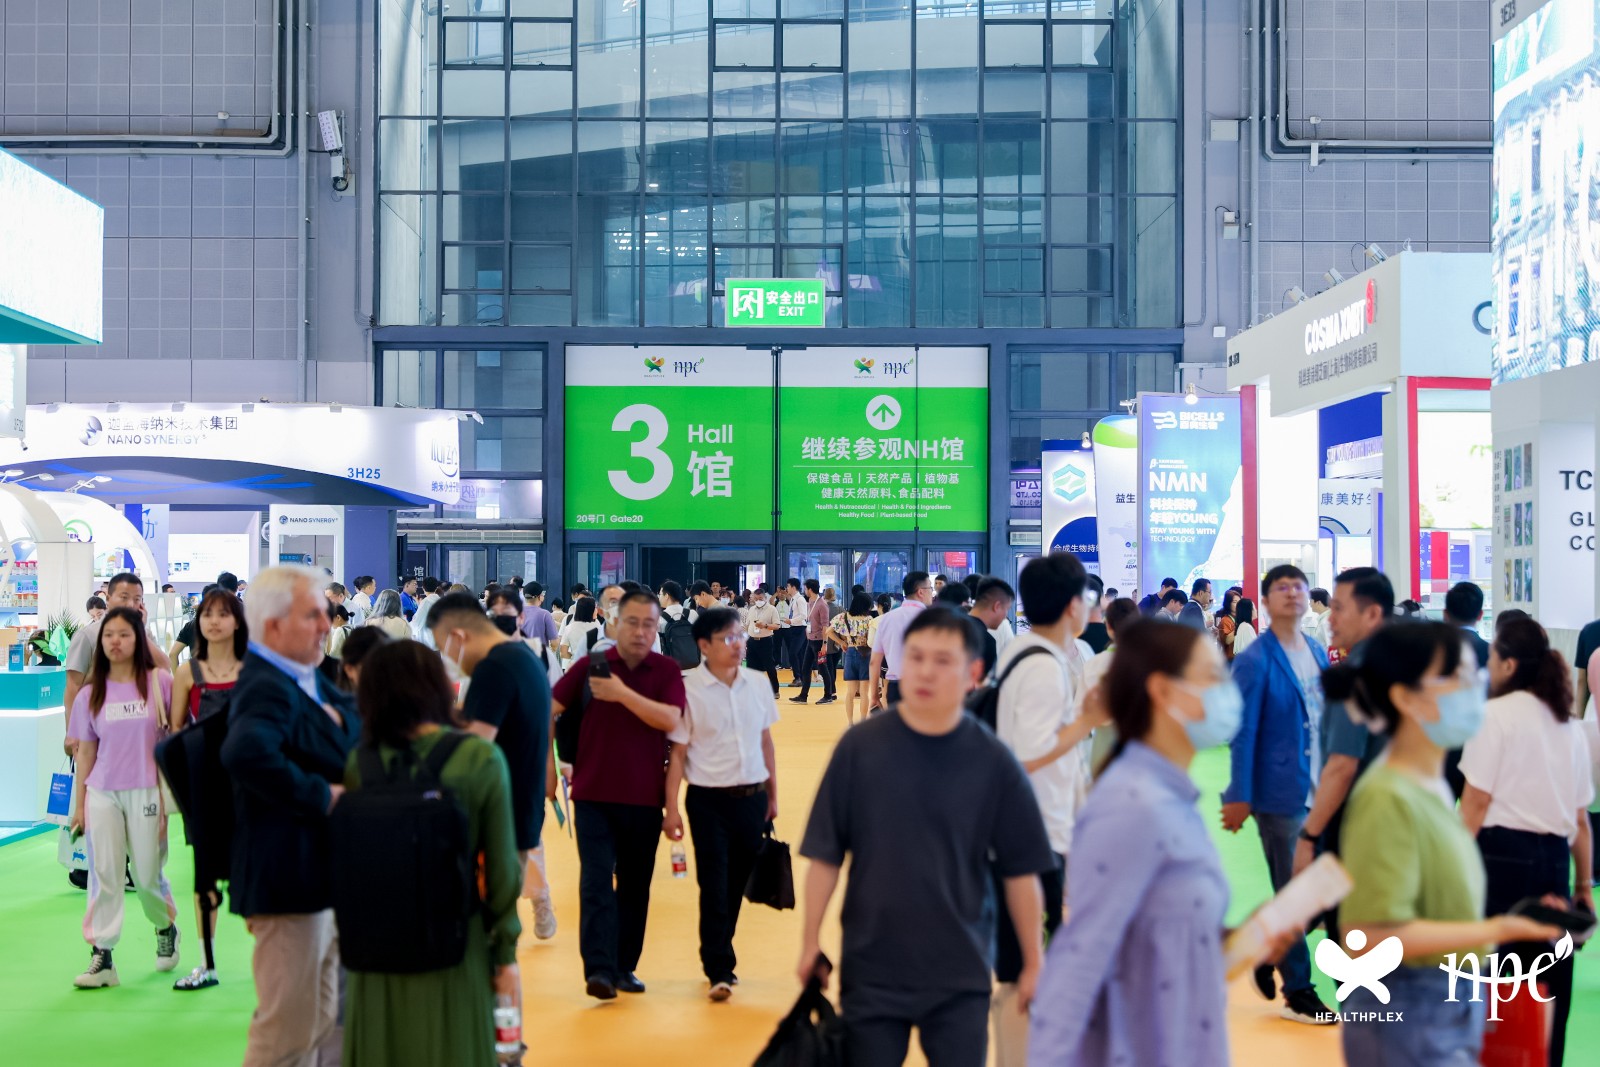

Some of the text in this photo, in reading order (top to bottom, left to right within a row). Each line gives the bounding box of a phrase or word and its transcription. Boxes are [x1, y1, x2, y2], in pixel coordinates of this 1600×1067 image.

[766, 290, 819, 305] 安全出口
[778, 306, 805, 316] EXIT
[673, 358, 703, 377] npc
[883, 358, 913, 378] npc
[107, 434, 142, 445] NANO
[688, 424, 733, 443] Hall
[607, 403, 674, 501] 3
[801, 436, 964, 461] 继续参观NH馆
[347, 467, 381, 479] 3H25
[686, 450, 734, 498] 馆
[807, 473, 960, 484] 保健食品 天然产品 植物基
[1149, 471, 1207, 492] NMN
[821, 487, 945, 499] 健康天然原料、食品配料
[1116, 493, 1136, 503] 益生
[576, 514, 643, 523] 20号门 Gate20
[1168, 527, 1195, 535] YOUNG
[1150, 535, 1195, 543] TECHNOLOGY
[413, 565, 424, 577] 馆
